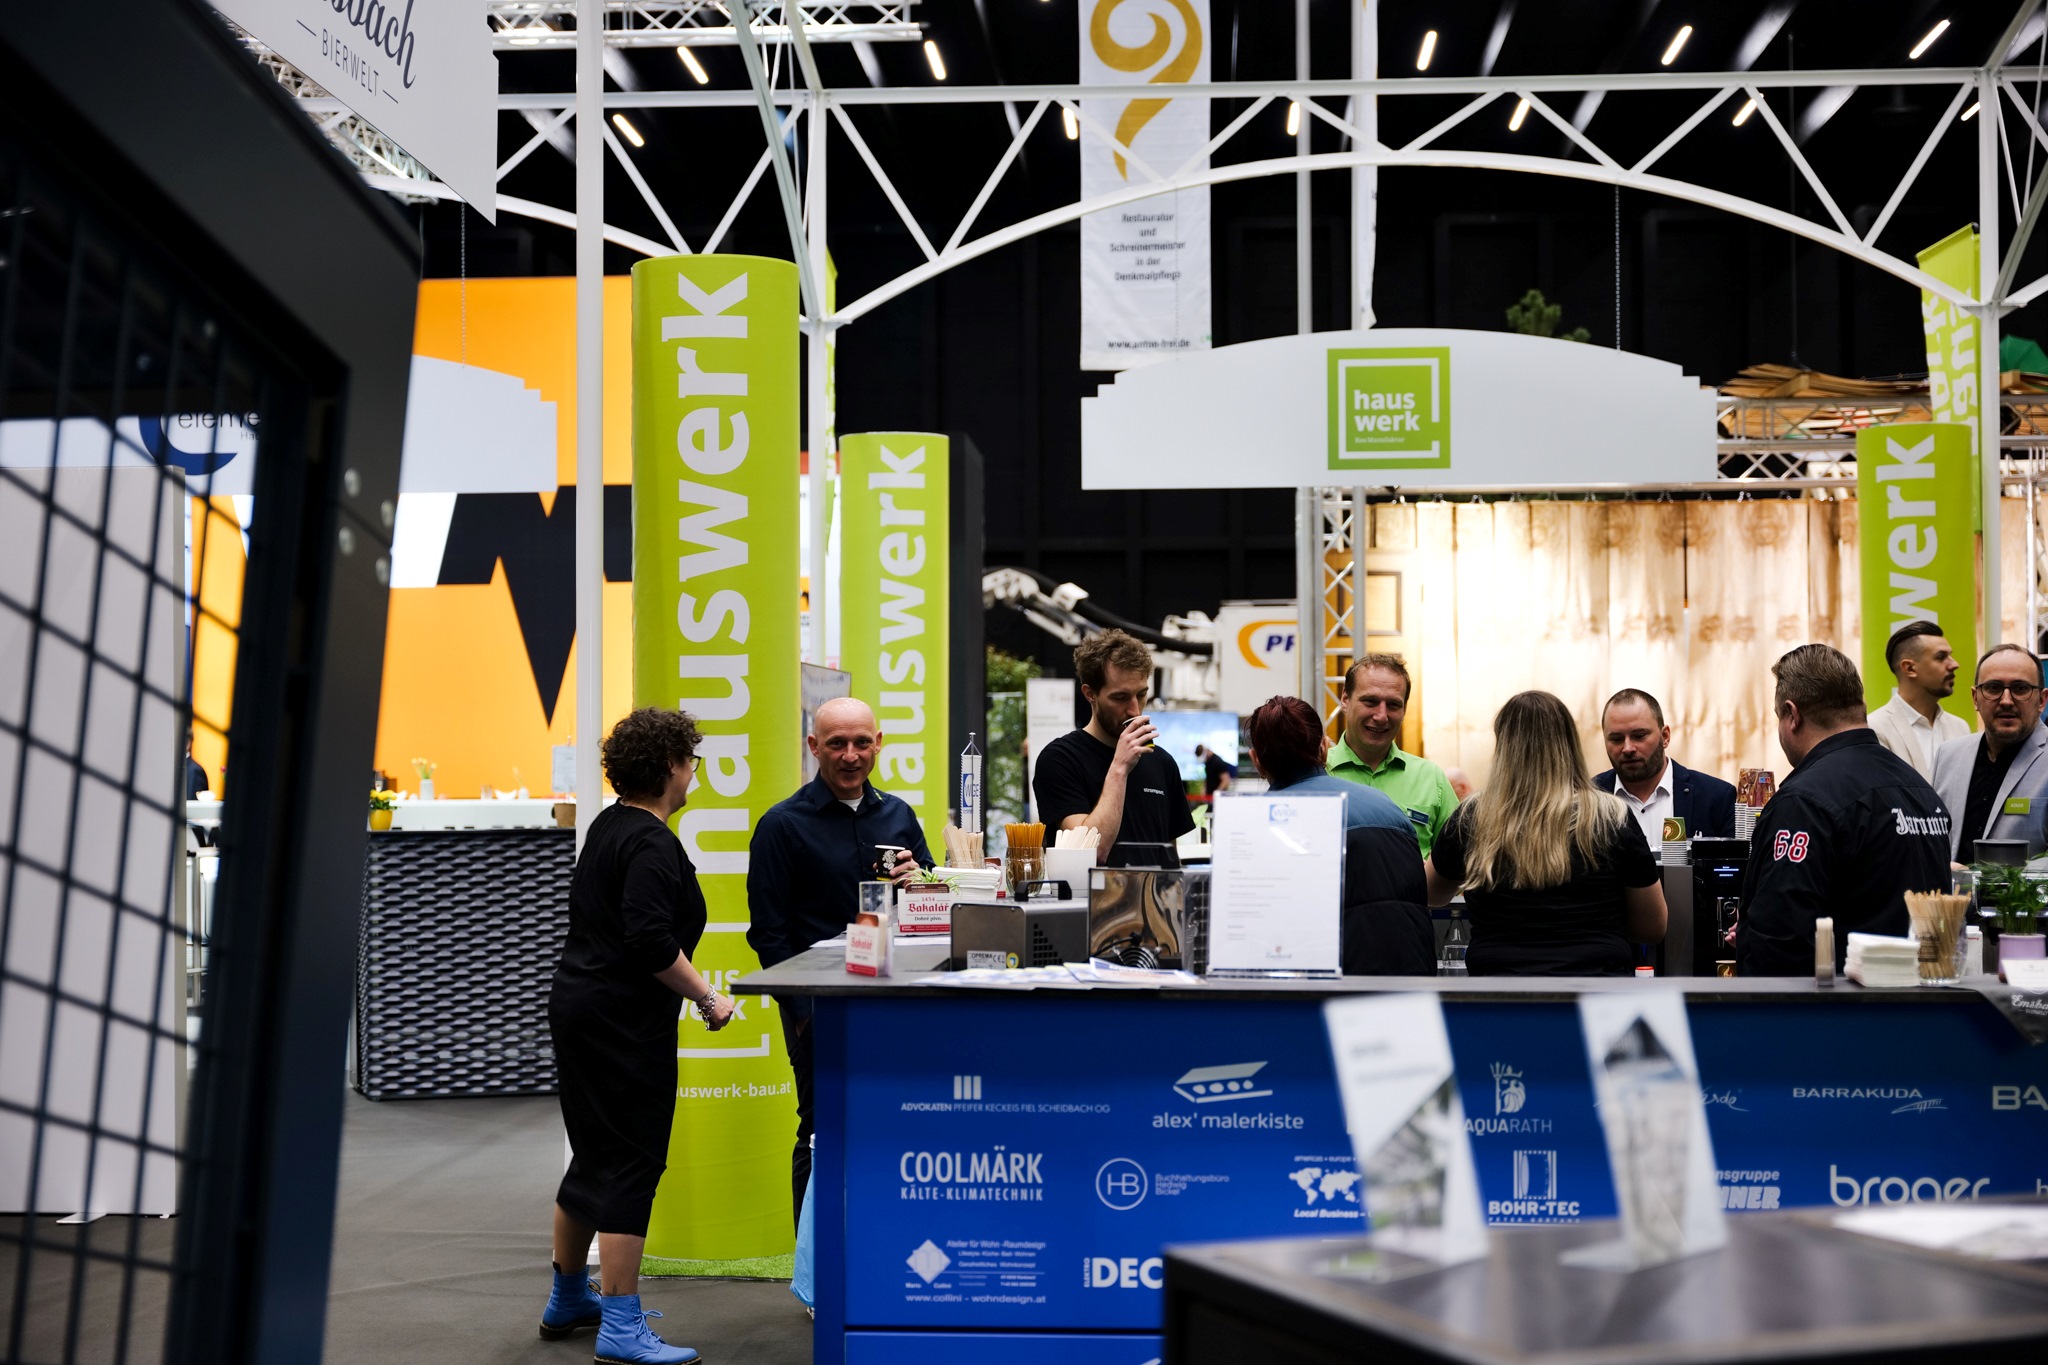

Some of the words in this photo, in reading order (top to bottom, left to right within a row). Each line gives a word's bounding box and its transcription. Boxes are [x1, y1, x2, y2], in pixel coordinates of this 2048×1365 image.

[322, 28, 379, 97] BIERWELT
[1139, 228, 1157, 237] und
[1353, 389, 1416, 410] haus
[1354, 410, 1421, 432] werk
[1874, 433, 1938, 636] werk
[1773, 829, 1811, 863] 68
[676, 1081, 791, 1098] uswerk-bau.at
[1793, 1087, 1923, 1098] BARRAKUDA
[900, 1103, 952, 1112] ADVOKATEN
[954, 1104, 983, 1112] PFEIFER
[985, 1104, 1020, 1113] KECKEIS
[1021, 1105, 1036, 1113] FIEL
[1037, 1104, 1093, 1113] SCHEIDBACH
[1094, 1105, 1110, 1114] OG
[1152, 1112, 1198, 1128] alex'
[1202, 1113, 1304, 1130] malerkiste
[1464, 1118, 1552, 1136] AQUARATH
[900, 1145, 1044, 1184] COOLMÄRK
[1107, 1173, 1140, 1196] HB
[1715, 1170, 1780, 1183] nsgruppe
[901, 1184, 1044, 1201] KÄLTE-KLIMATECHNIK
[1293, 1209, 1318, 1218] Local
[1319, 1210, 1359, 1218] Business
[1488, 1201, 1580, 1216] BOHR-TEC
[905, 1294, 963, 1303] www.collini
[972, 1295, 1047, 1305] wohndesign.at
